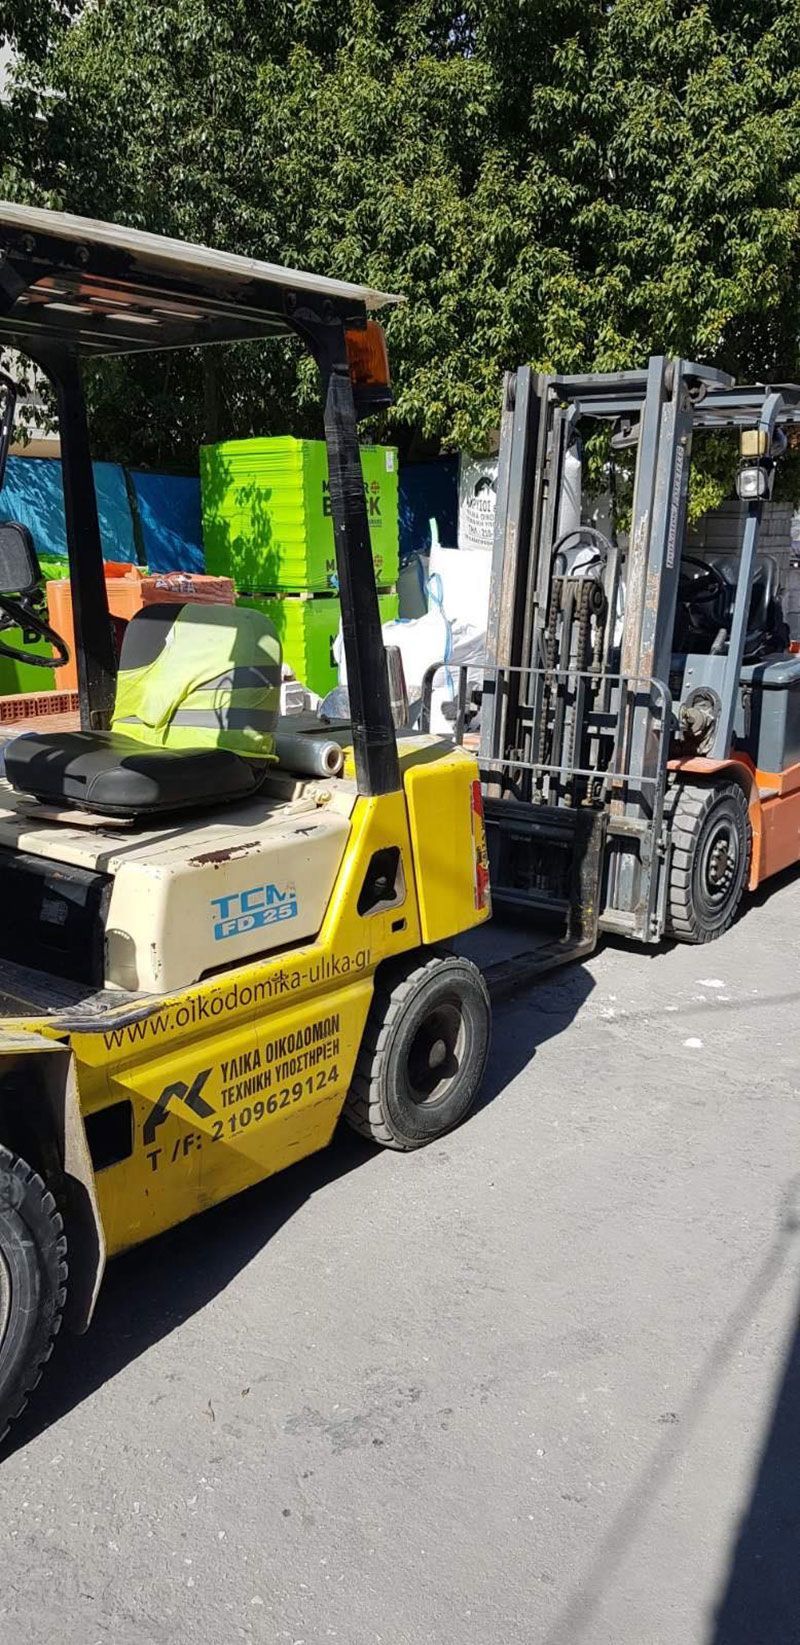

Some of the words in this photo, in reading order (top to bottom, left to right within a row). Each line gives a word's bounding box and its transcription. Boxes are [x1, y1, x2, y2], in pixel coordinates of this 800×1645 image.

[211, 884, 296, 919] TCM
[221, 915, 255, 936] FD
[263, 904, 293, 921] 25
[221, 1048, 262, 1083] ΥΛΙΚΑ
[266, 1014, 340, 1064] ΟΙΚΟΔΟΜΩΝ
[221, 1069, 272, 1108] ΤΕΧΝΙΚΗ
[275, 1038, 340, 1082] ΥΠΟΣΤΗΡΙΞΗ
[212, 1064, 339, 1142] 2109629124
